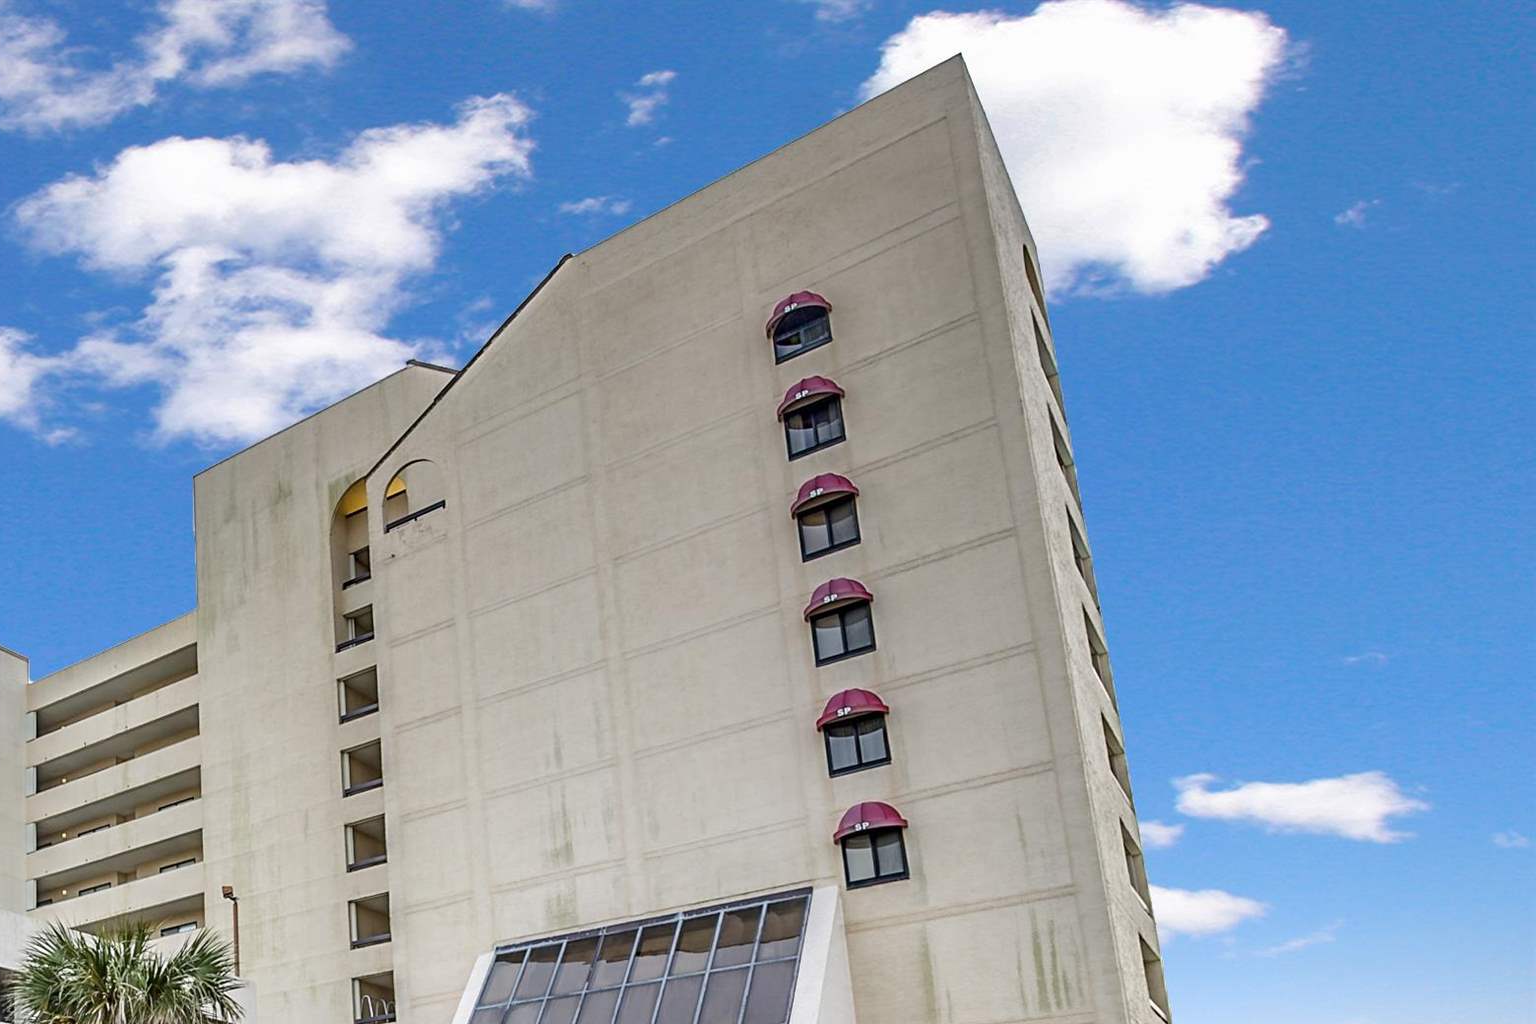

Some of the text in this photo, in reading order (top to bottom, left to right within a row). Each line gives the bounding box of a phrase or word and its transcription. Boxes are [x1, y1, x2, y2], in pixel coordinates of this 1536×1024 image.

[784, 303, 798, 312] SP
[795, 389, 809, 399] SP
[810, 488, 823, 498] SP
[824, 594, 838, 603] SP
[837, 707, 851, 717] SP
[855, 822, 869, 831] SP
